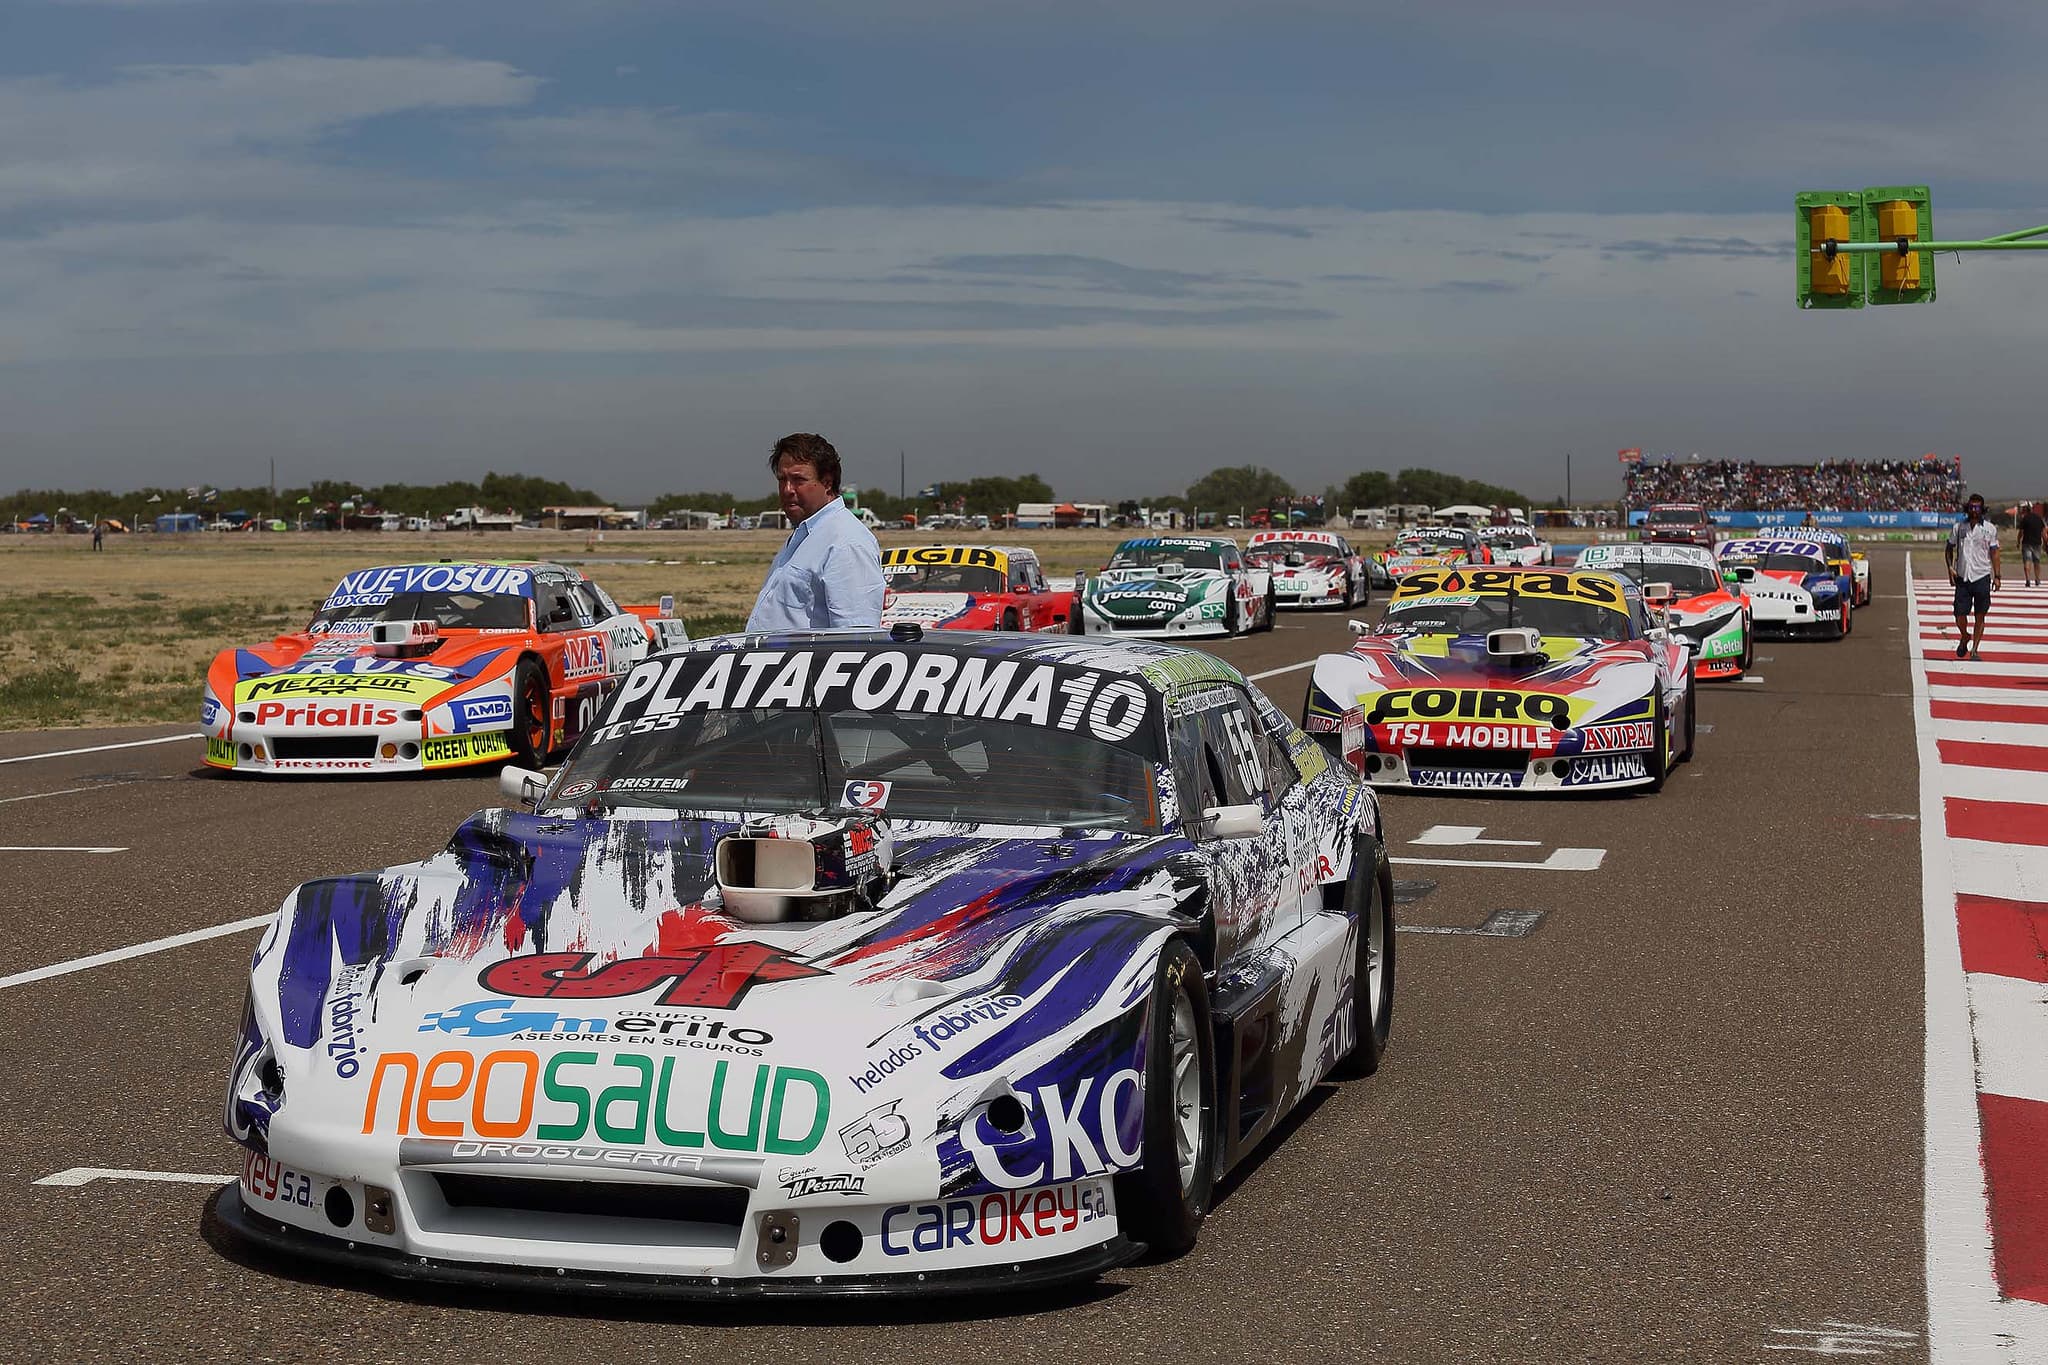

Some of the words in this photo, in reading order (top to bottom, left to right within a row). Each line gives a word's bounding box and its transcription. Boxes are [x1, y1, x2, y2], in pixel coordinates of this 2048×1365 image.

[1756, 514, 1785, 523] YPF
[1868, 514, 1898, 524] YPF
[1477, 528, 1533, 537] CORVEN
[1148, 600, 1177, 612] .com
[1201, 603, 1225, 619] SPS
[329, 622, 376, 634] PRONT
[1373, 690, 1570, 720] COIRO
[255, 701, 398, 727] Prialis
[1386, 722, 1435, 746] TSL
[1446, 725, 1554, 750] MOBILE
[424, 740, 468, 761] GREEN
[609, 777, 690, 790] CRISTEM
[1433, 772, 1514, 789] ALIANZA
[616, 1009, 708, 1021] GRUPO
[326, 992, 368, 1079] fabrizio
[846, 1041, 924, 1095] helados
[914, 991, 1025, 1053] fabrizio
[510, 1032, 622, 1045] ASESORES
[627, 1035, 665, 1049] EN
[669, 1039, 765, 1058] SEGUROS
[451, 1142, 705, 1168] DROGUERIA
